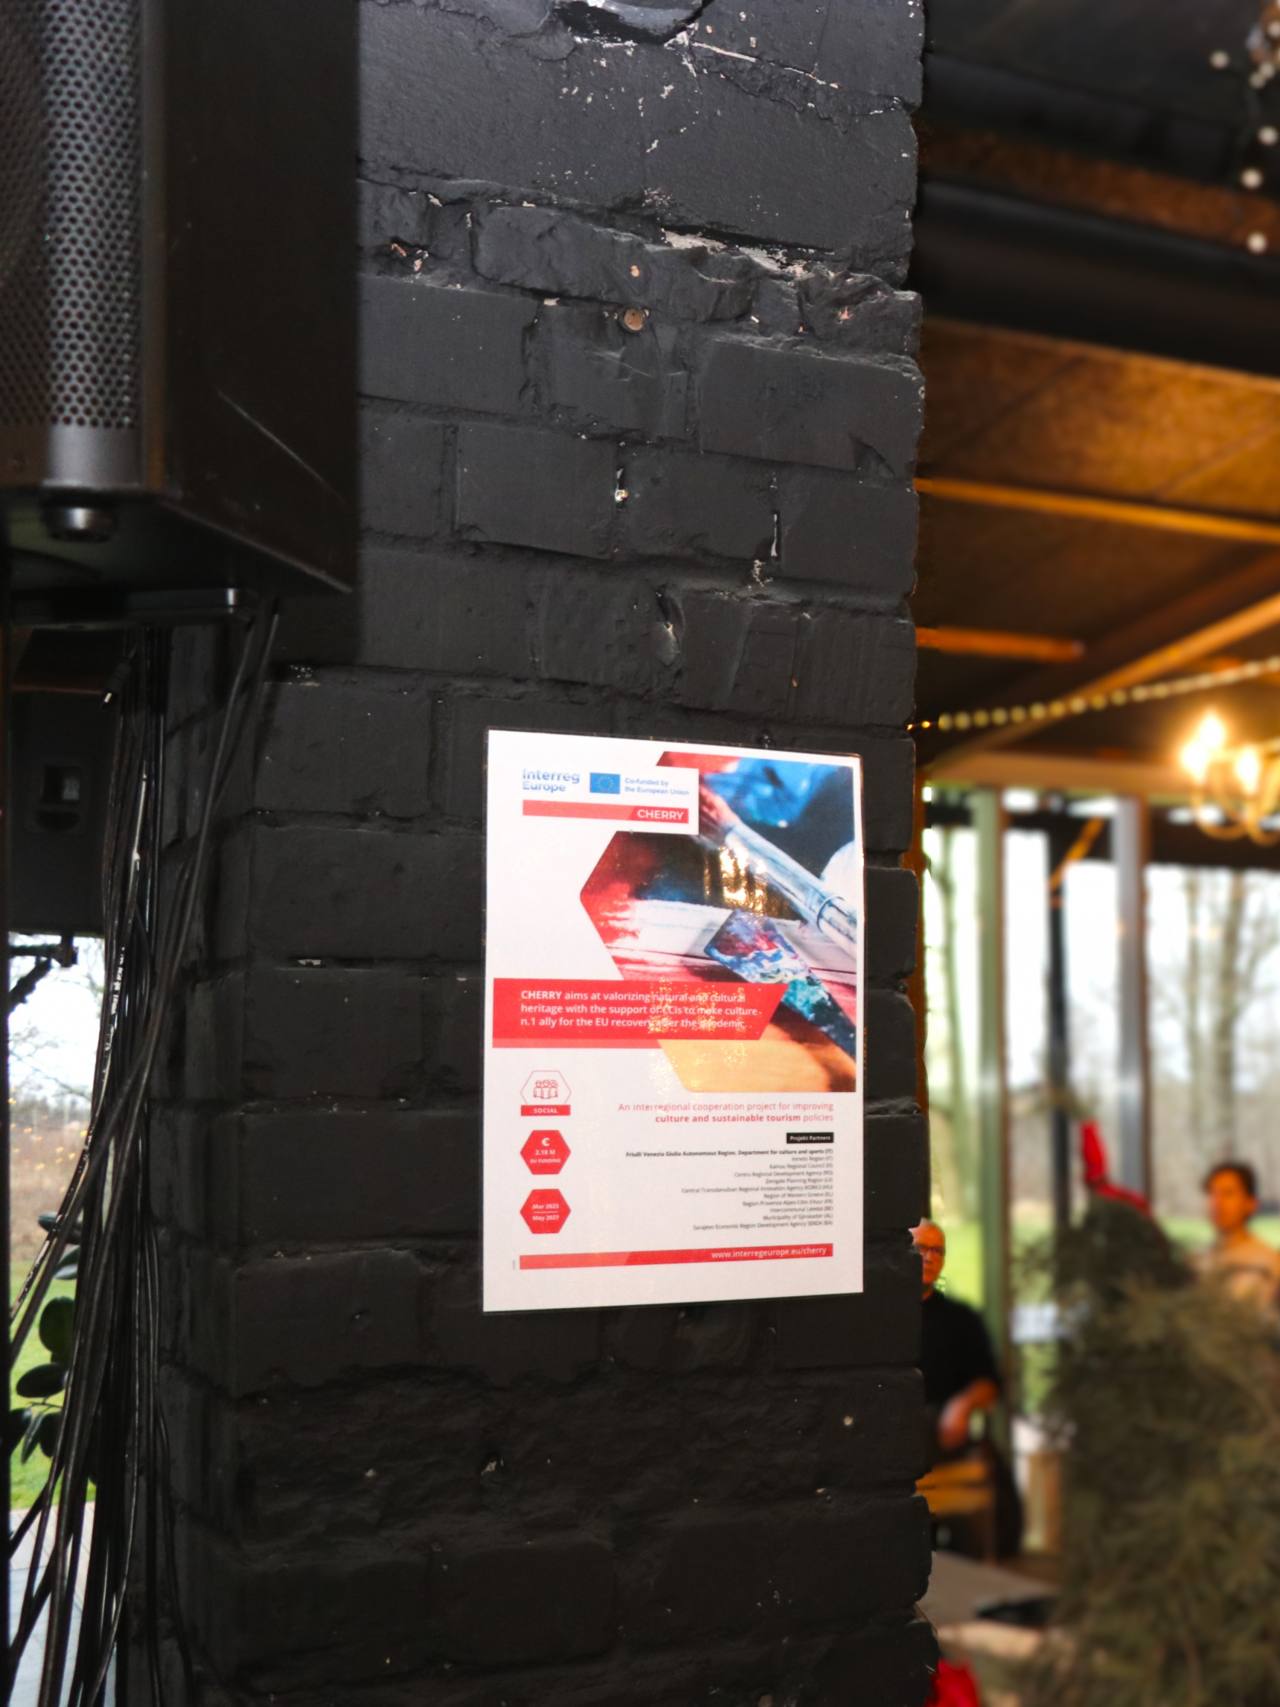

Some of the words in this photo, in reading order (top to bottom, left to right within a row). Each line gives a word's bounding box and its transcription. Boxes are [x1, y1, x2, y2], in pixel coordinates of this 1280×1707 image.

[522, 768, 580, 784] Interreg
[522, 781, 566, 793] Europe
[637, 809, 685, 821] CHERRY
[521, 990, 562, 1000] CHERRY
[565, 991, 588, 1000] aims
[591, 992, 601, 1000] at
[603, 991, 651, 1004] valorizing
[653, 992, 688, 1001] natural
[521, 1004, 563, 1015] heritage
[565, 1004, 587, 1013] with
[590, 1005, 607, 1013] the
[609, 1005, 647, 1016] support
[684, 1006, 695, 1014] to
[725, 1006, 758, 1015] culture
[521, 1018, 536, 1026] n.1
[539, 1017, 557, 1028] ally
[559, 1017, 573, 1026] for
[576, 1017, 593, 1026] the
[595, 1018, 609, 1026] EU
[611, 1018, 651, 1029] recovery
[681, 1019, 696, 1027] the
[618, 1103, 630, 1111] An
[692, 1102, 745, 1112] cooperation
[747, 1102, 776, 1112] project
[778, 1102, 790, 1110] for
[793, 1102, 834, 1111] improving
[655, 1114, 689, 1123] culture
[692, 1114, 709, 1122] and
[712, 1113, 764, 1122] sustainable
[767, 1113, 801, 1122] tourism
[803, 1113, 833, 1123] policies
[711, 1246, 827, 1260] www.interregeurope.eu/cherry
